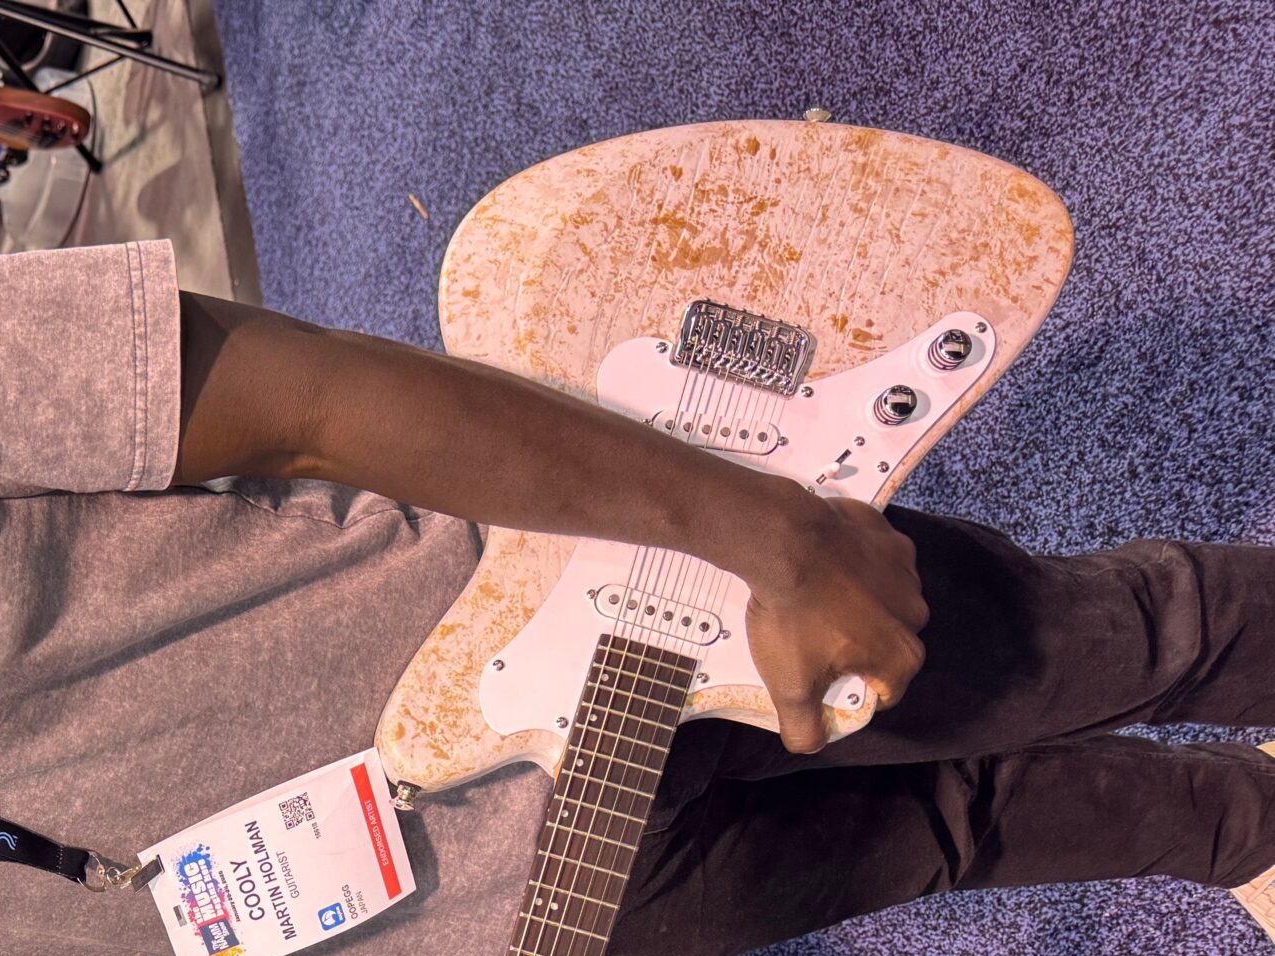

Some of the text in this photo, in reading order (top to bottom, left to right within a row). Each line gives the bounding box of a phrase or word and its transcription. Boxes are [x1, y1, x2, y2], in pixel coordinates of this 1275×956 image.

[363, 799, 390, 866] ENDORSED ARTIST
[184, 862, 217, 921] MUSIC
[198, 858, 224, 916] begins here
[230, 859, 266, 921] COOLY
[245, 819, 297, 940] MARTIN HOLMAN
[276, 851, 301, 899] GUITARIST
[193, 906, 203, 923] the
[231, 901, 240, 922] January
[341, 884, 359, 920] OOPEGG
[355, 891, 369, 914] JAPAN
[209, 923, 229, 950] NAMM
[218, 922, 229, 937] Show
